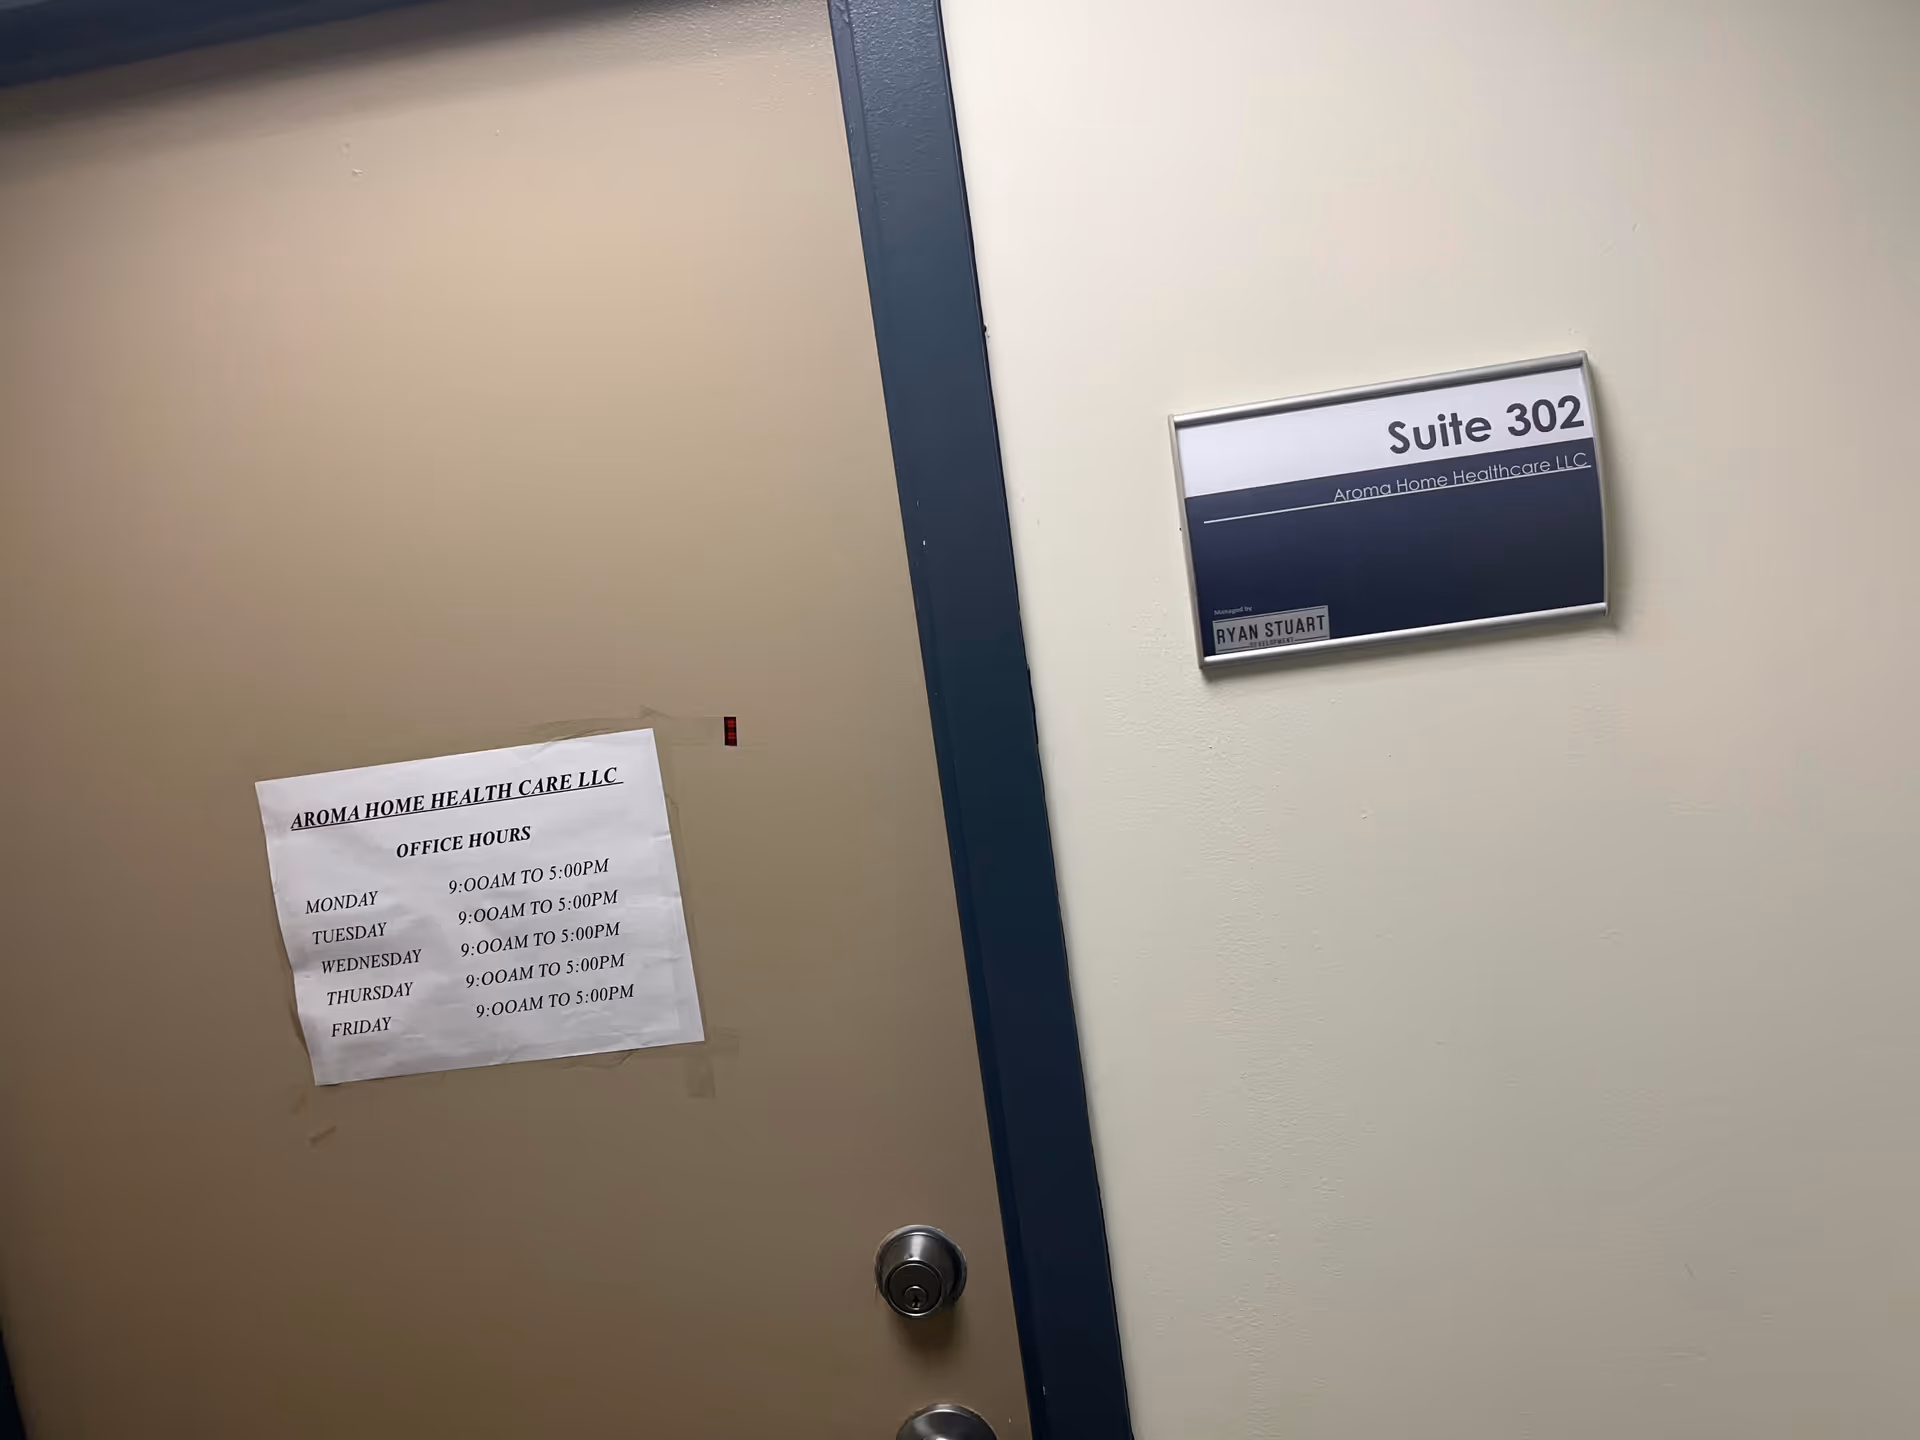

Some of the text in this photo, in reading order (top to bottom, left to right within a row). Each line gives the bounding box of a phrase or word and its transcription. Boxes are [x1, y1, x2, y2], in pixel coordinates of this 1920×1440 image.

[1388, 394, 1585, 454] Suite 302
[1333, 452, 1588, 502] Aroma Home Healthcare LLC
[1214, 607, 1243, 616] Managed
[1216, 615, 1325, 645] RYAN STUART
[290, 767, 617, 830] AROMA HOME HEALTH CARE LLC
[396, 825, 531, 858] OFFICE HOURS
[305, 890, 379, 915] MONDAY
[521, 868, 543, 884] TO
[549, 858, 609, 880] 5:00PM
[312, 922, 387, 946] TUESDAY
[530, 899, 552, 915] TO
[558, 889, 618, 911] 5:00PM
[321, 948, 422, 975] WEDNESDAY
[533, 931, 555, 946] TO
[561, 922, 620, 943] 5:00PM
[327, 982, 414, 1007] THURSDAY
[538, 962, 560, 978] TO
[566, 953, 625, 974] 5:00PM
[330, 1017, 392, 1038] FRIDAY
[548, 992, 570, 1008] TO
[575, 984, 634, 1005] 5:00PM
